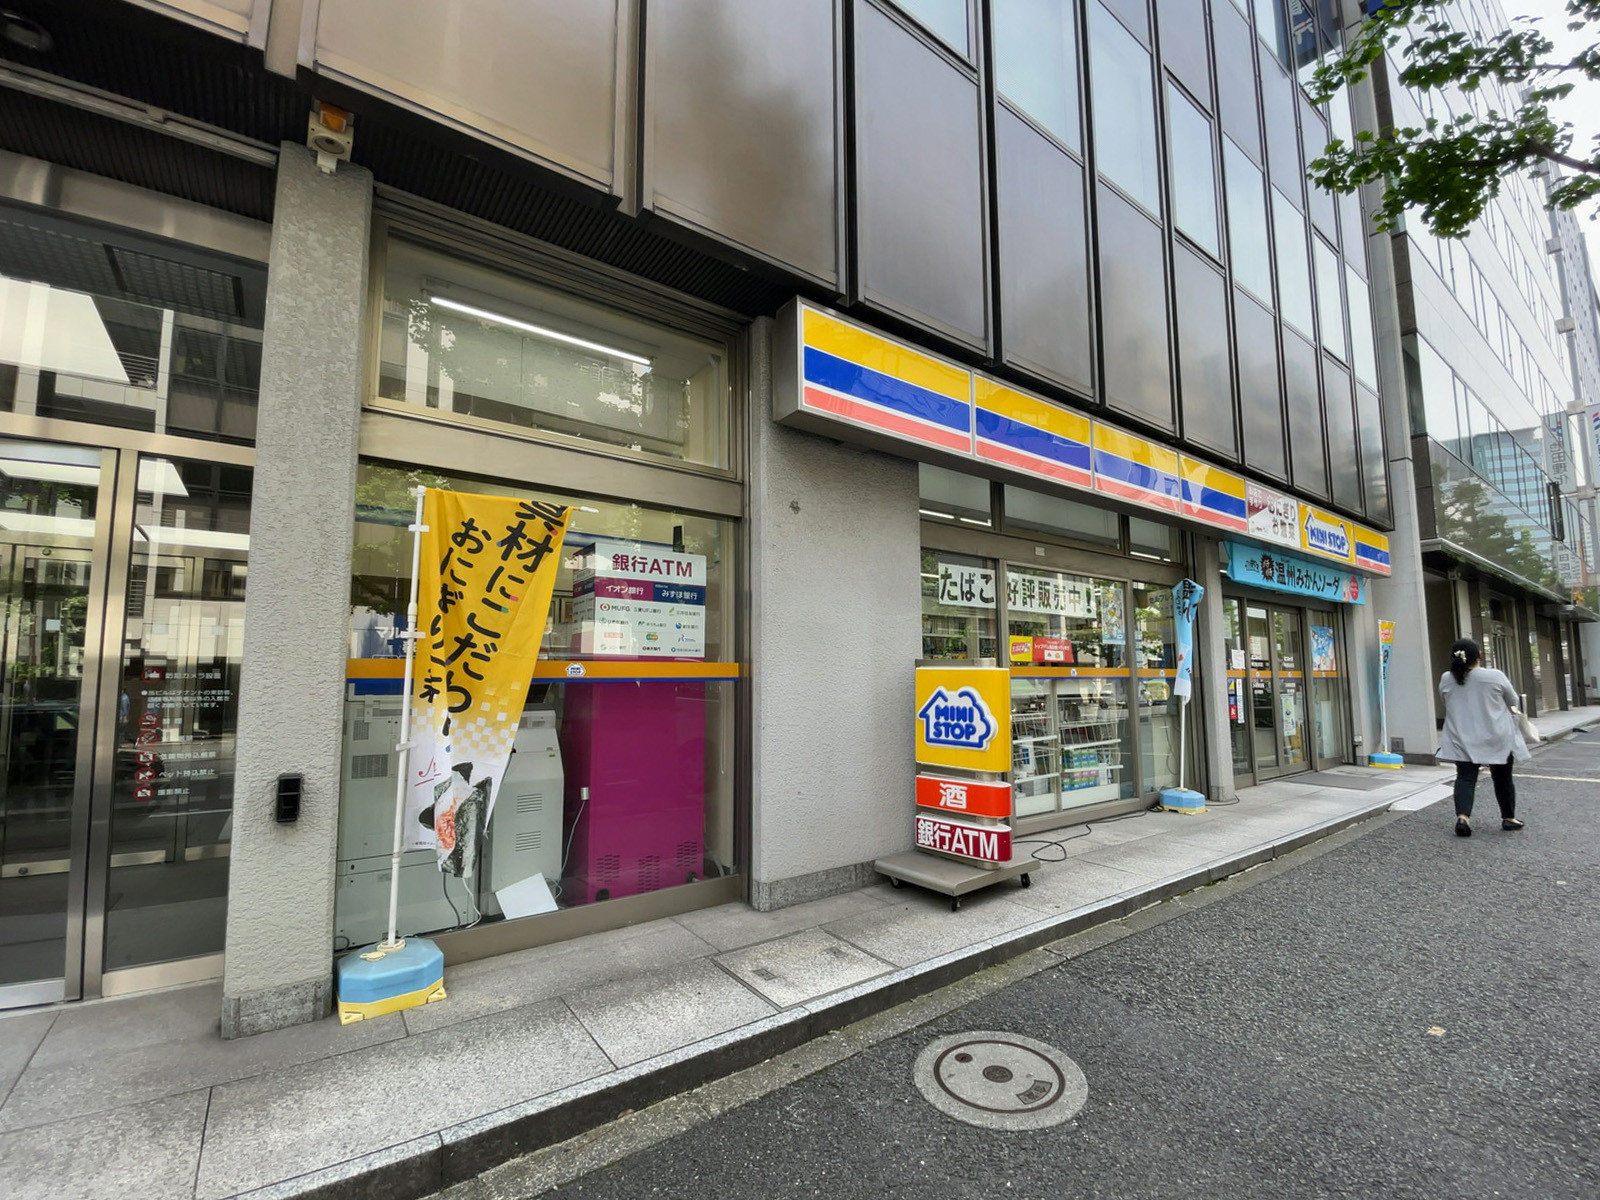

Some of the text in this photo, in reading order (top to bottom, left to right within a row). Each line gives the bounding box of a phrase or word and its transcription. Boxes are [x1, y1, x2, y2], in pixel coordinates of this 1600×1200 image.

[1309, 525, 1347, 551] MINI STOP
[612, 553, 693, 578] 銀行ATM
[605, 584, 644, 596] イオン銀行
[939, 566, 995, 603] たばこ
[1275, 561, 1341, 596] 温州みかんソーダ
[661, 589, 698, 601] みずほ銀行
[935, 704, 974, 722] MINI
[933, 721, 977, 740] STOP
[939, 782, 967, 810] 酒
[917, 819, 998, 860] 銀行ATM
